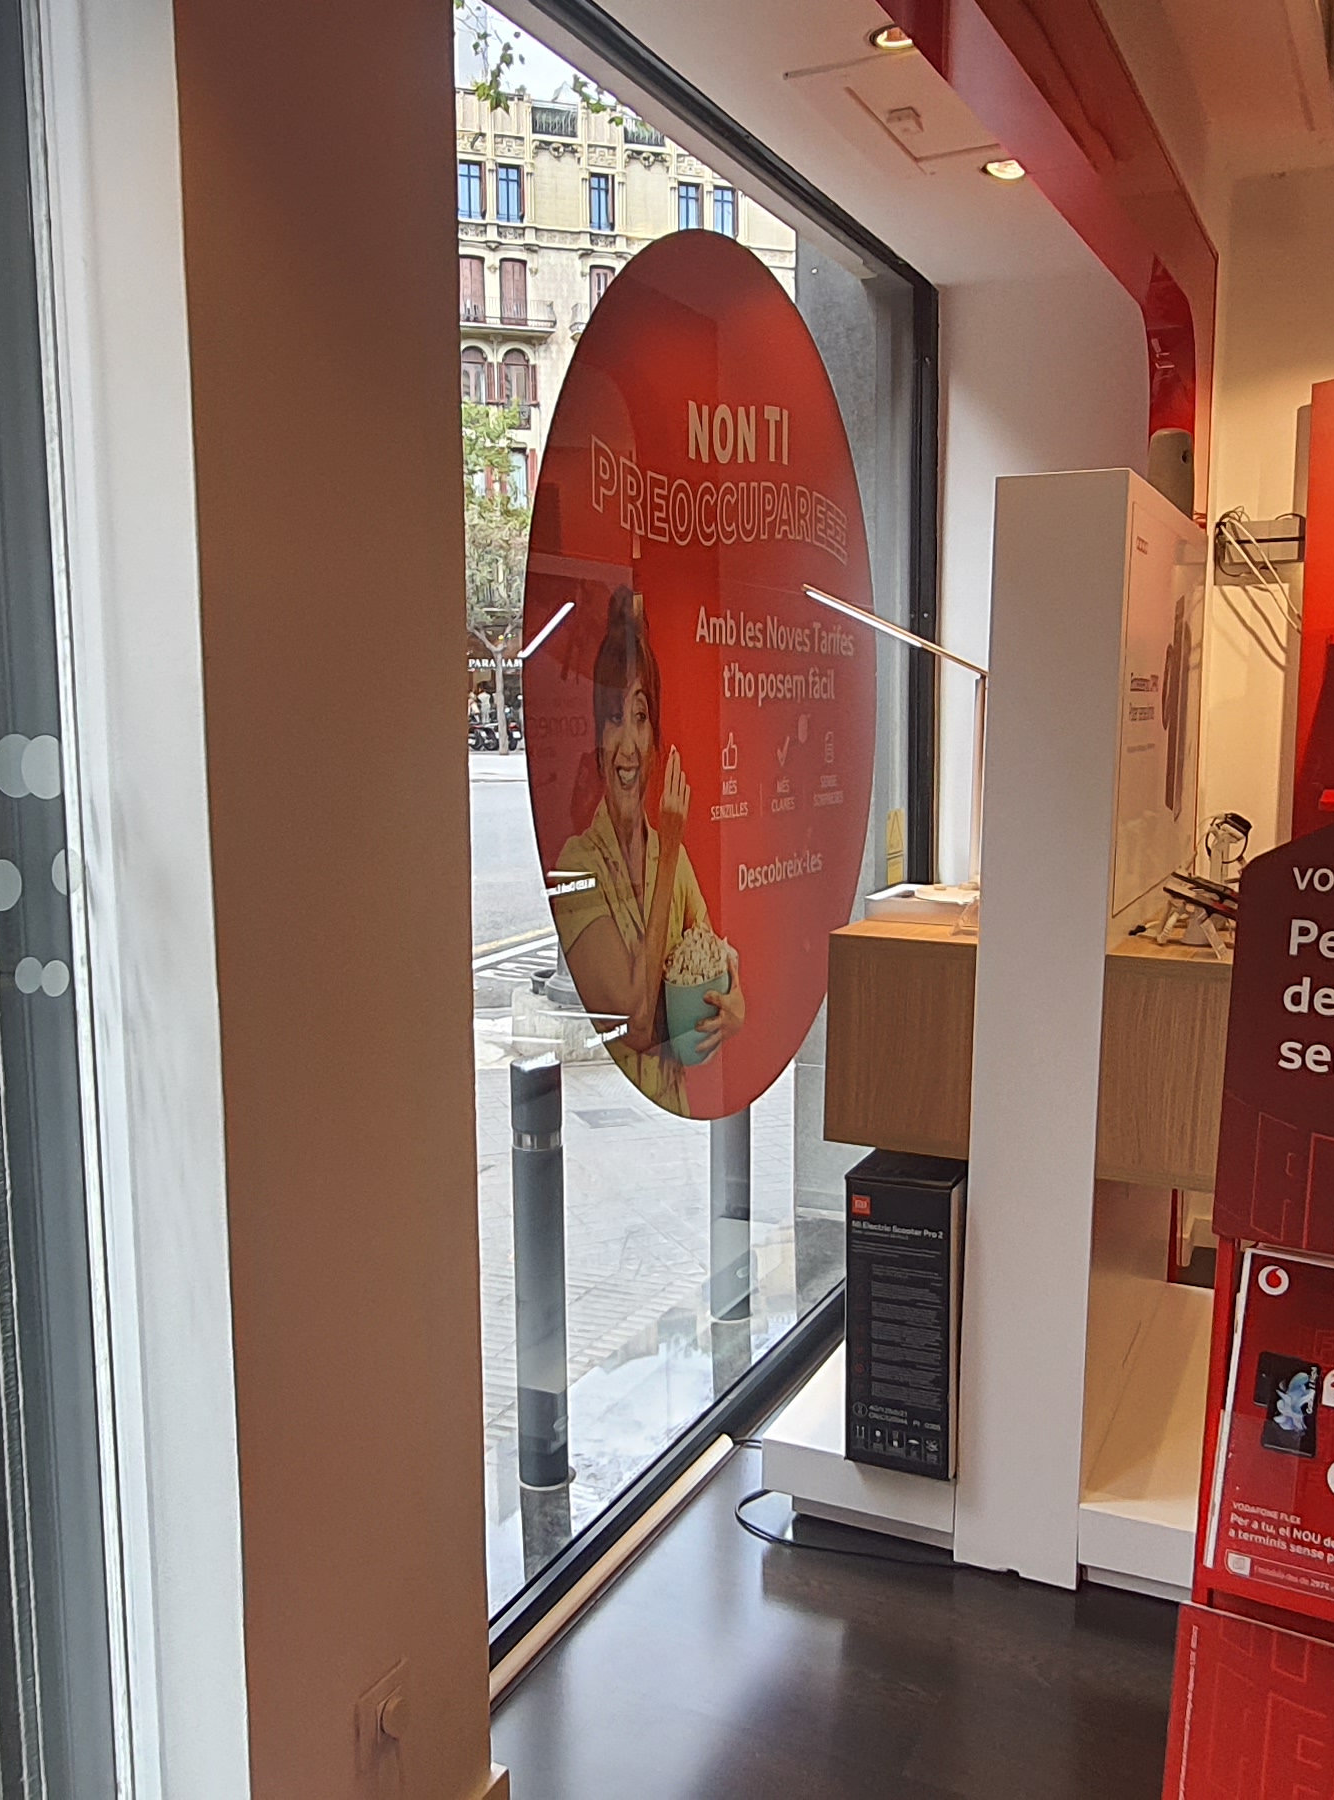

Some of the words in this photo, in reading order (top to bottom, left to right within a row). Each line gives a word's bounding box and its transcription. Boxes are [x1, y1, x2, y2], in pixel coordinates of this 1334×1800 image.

[688, 400, 756, 464] NON
[763, 404, 789, 465] TI
[696, 605, 736, 646] Amb
[740, 611, 763, 648] les
[767, 615, 811, 653] Noves
[812, 621, 854, 656] Tarifes
[723, 662, 755, 698] t'ho
[758, 671, 806, 707] posem
[893, 1225, 923, 1237] Scooter
[924, 1229, 937, 1238] Pro
[938, 1231, 944, 1239] 2
[1230, 1512, 1249, 1526] Per
[1251, 1520, 1259, 1530] a
[1278, 1526, 1291, 1538] el
[1292, 1527, 1322, 1545] NOU
[1232, 1501, 1279, 1519] VODAFONE
[1279, 1512, 1301, 1525] FLEX
[1228, 1527, 1236, 1538] a
[1237, 1528, 1288, 1550] terminis
[1289, 1538, 1325, 1560] sense
